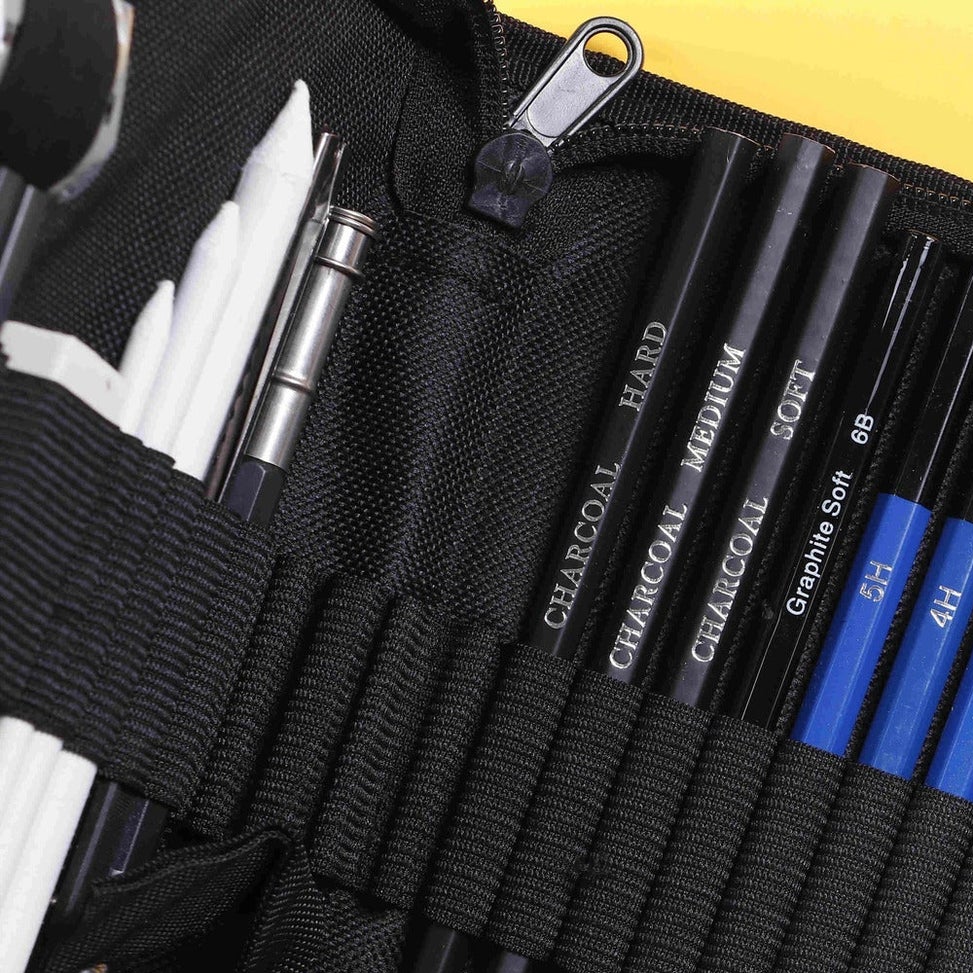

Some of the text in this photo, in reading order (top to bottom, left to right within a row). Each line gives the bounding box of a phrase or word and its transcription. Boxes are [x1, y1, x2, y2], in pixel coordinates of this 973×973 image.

[544, 320, 667, 630] CHARCOAL HARD
[609, 342, 747, 670] CHARCOAL MEDIUM
[691, 359, 816, 663] CHARCOAL SOFT
[786, 413, 875, 617] Graphite Soft 6B
[859, 560, 893, 603] 5H
[929, 585, 962, 629] 4H
